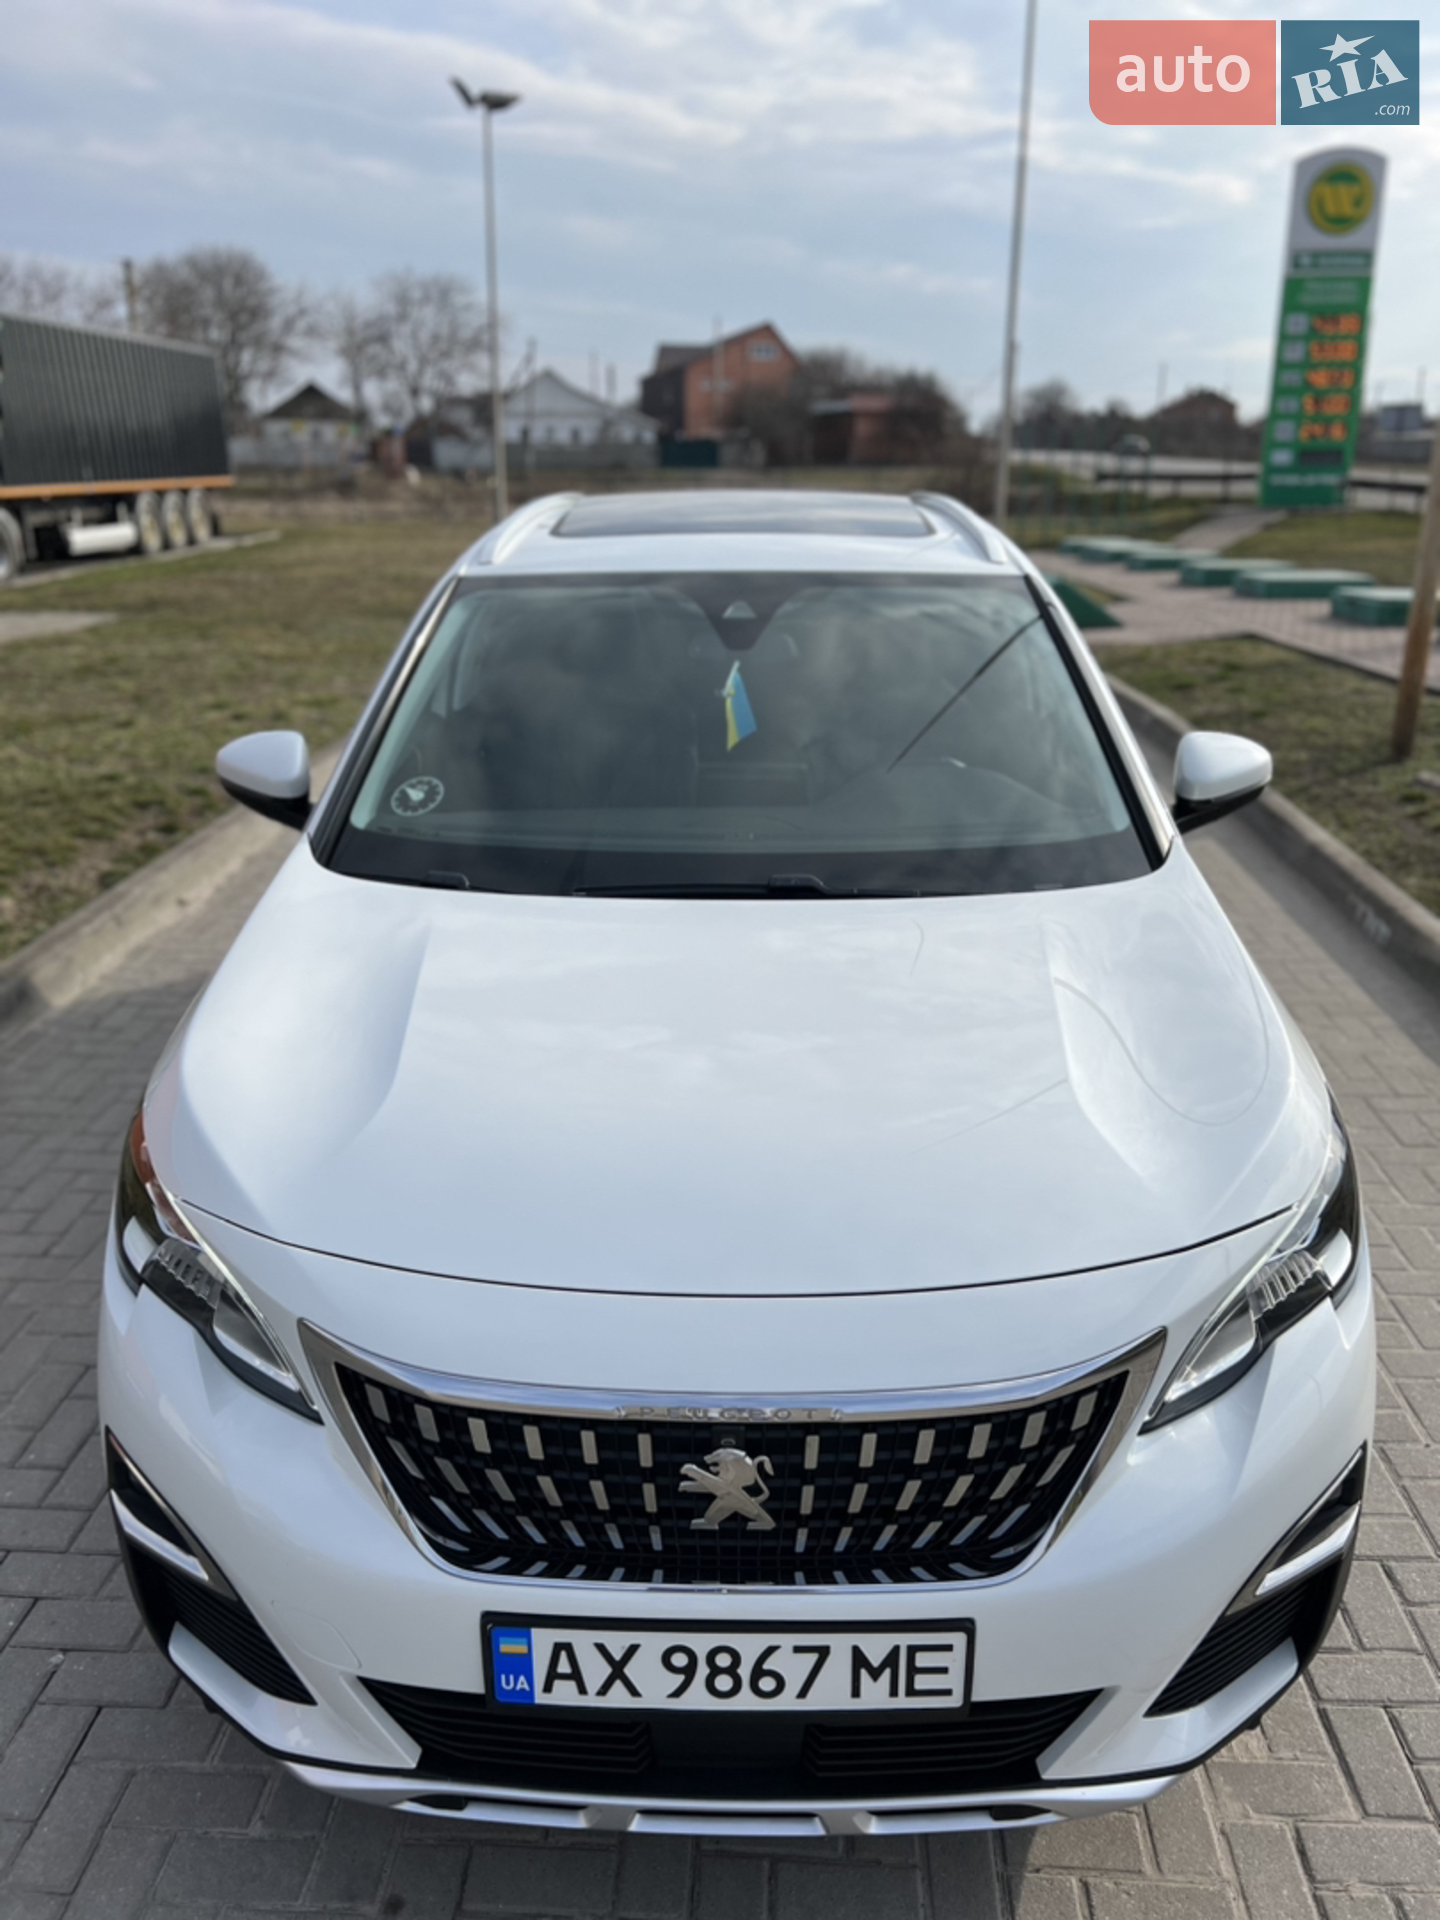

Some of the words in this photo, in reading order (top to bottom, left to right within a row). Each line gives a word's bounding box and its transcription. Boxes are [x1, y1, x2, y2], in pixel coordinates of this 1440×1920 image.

[639, 1407, 819, 1421] PEUGEOT
[542, 1641, 643, 1698] AX
[660, 1644, 831, 1700] 9867
[850, 1643, 954, 1699] ME
[500, 1673, 531, 1692] UA
